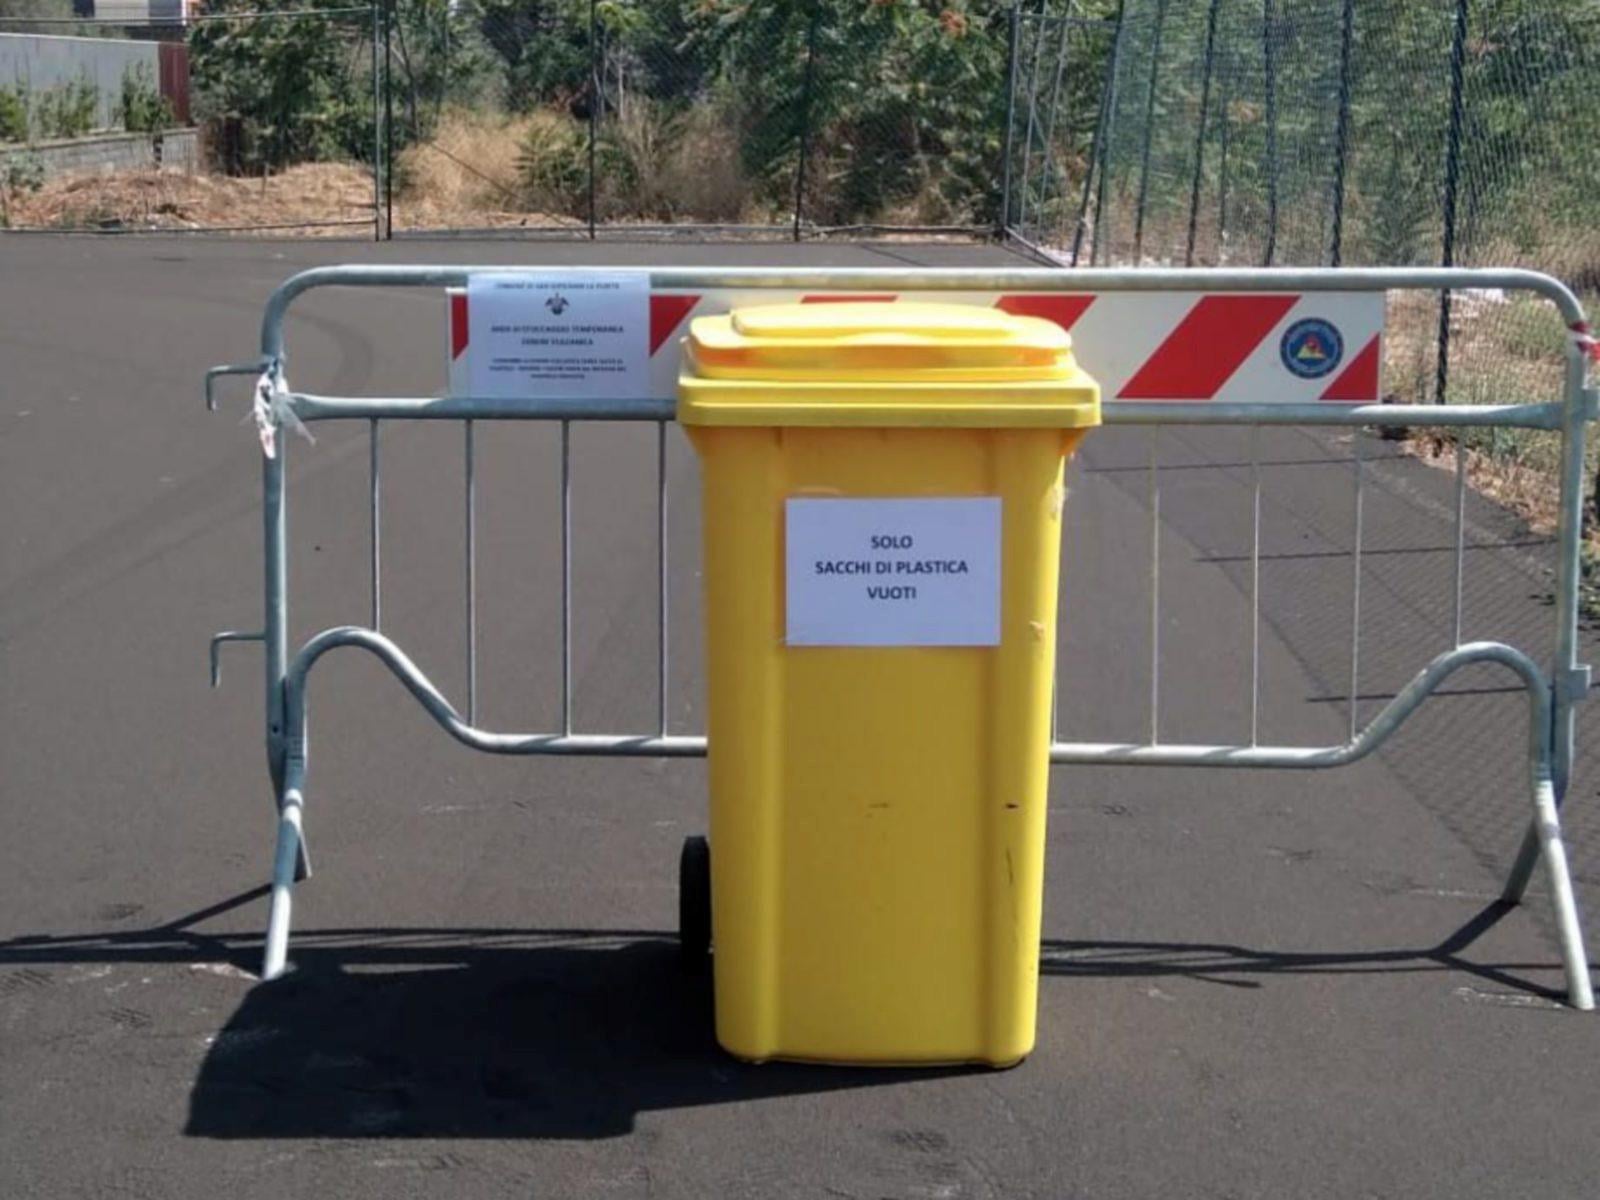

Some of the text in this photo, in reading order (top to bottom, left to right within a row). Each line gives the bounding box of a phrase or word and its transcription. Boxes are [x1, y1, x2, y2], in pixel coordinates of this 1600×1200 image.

[871, 535, 913, 550] SOLO
[815, 560, 968, 575] SACCHI DI PLASTICA
[867, 586, 917, 600] VUOTI
